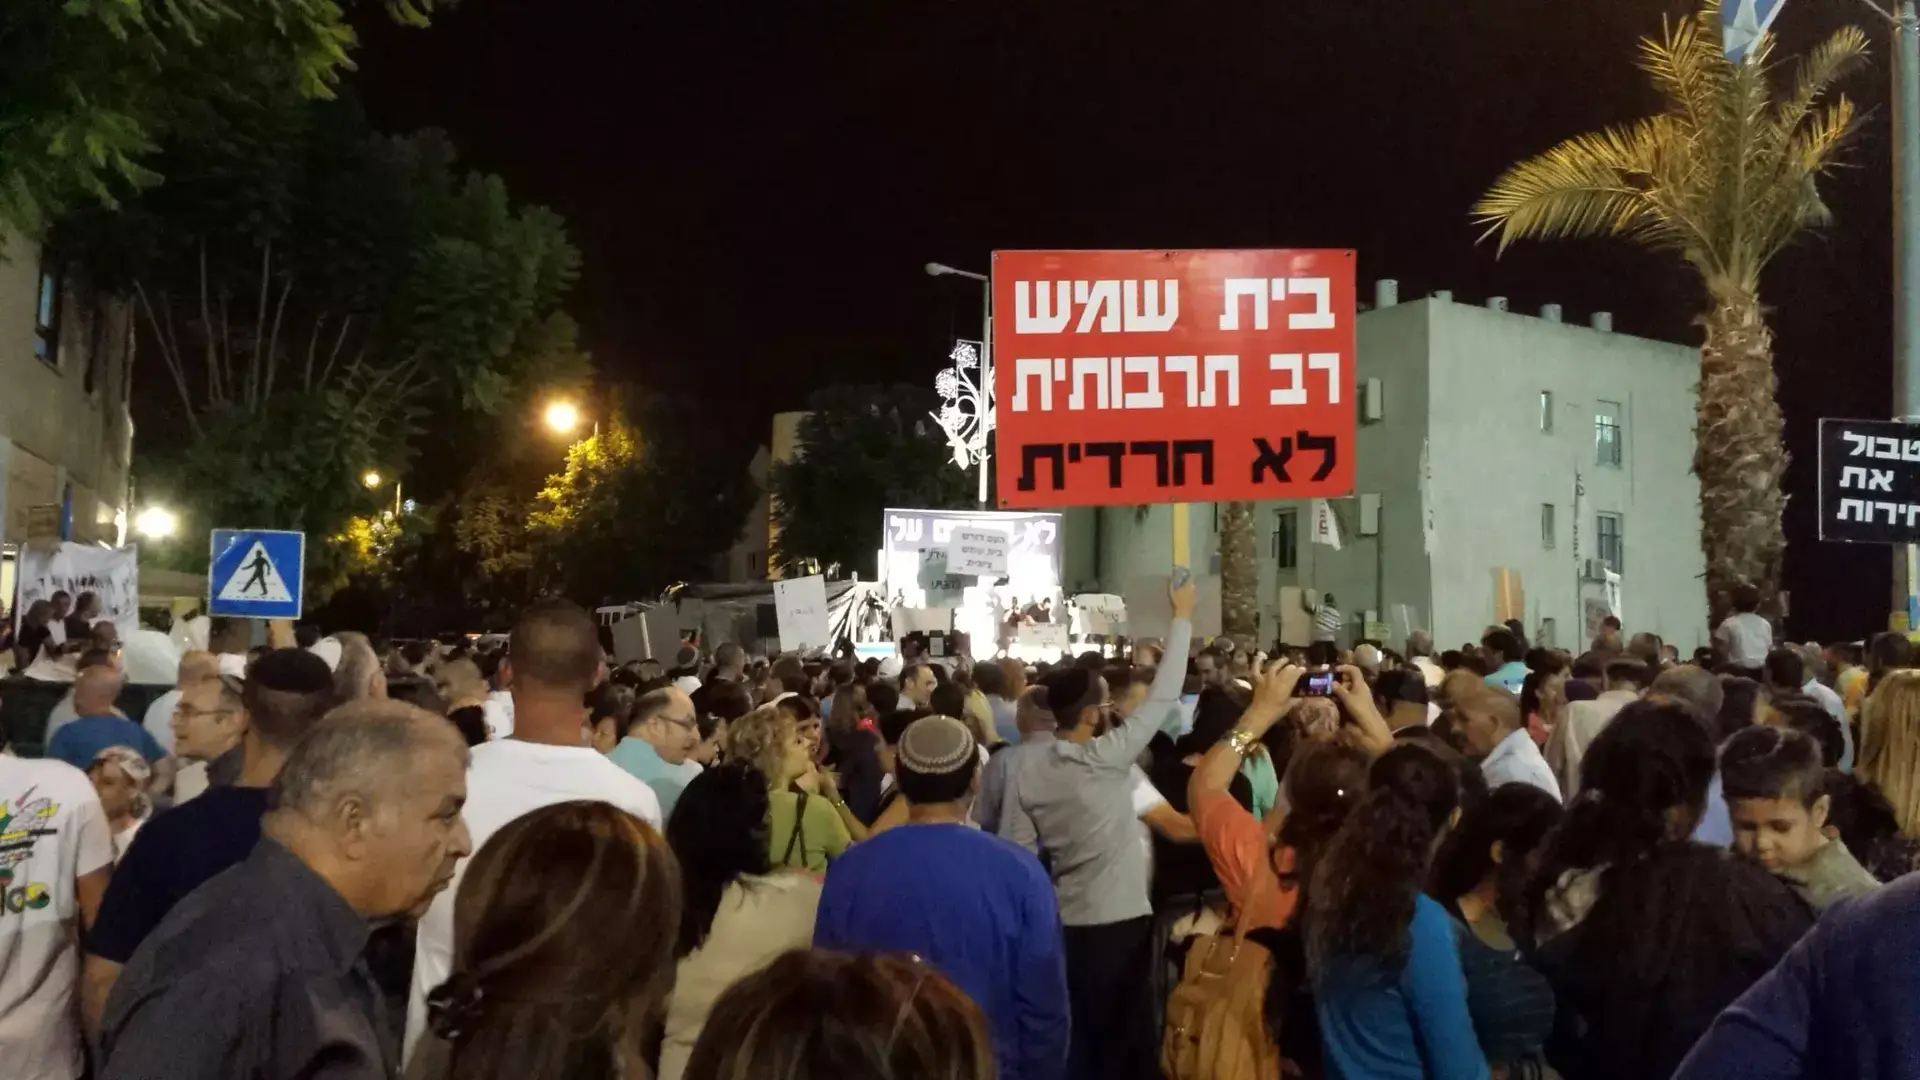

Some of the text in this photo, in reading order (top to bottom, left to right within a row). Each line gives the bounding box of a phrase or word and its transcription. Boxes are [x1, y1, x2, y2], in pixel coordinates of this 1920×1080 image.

[1015, 277, 1335, 334] בית שמש
[1012, 353, 1340, 412] רב תרבותית
[1017, 431, 1337, 491] לא חרדית
[1839, 466, 1895, 492] את
